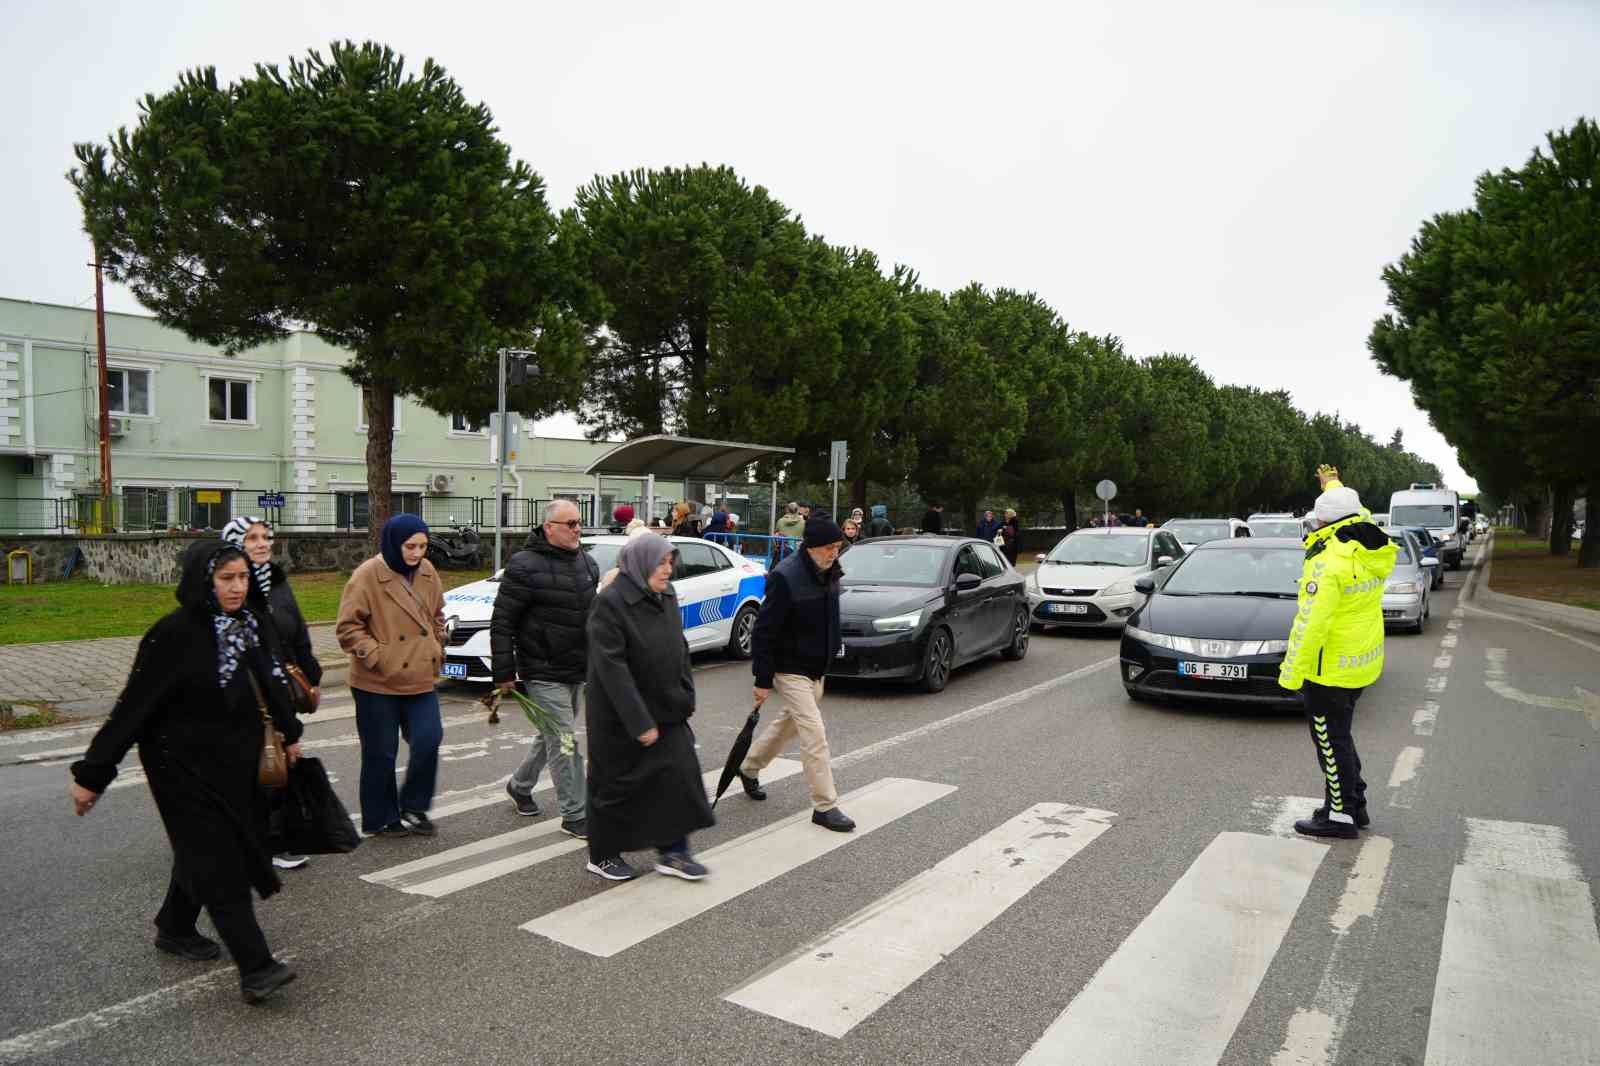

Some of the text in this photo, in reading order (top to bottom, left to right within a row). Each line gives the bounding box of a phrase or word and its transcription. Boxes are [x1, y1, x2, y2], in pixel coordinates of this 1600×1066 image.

[1185, 662, 1245, 677] 06 F 3791
